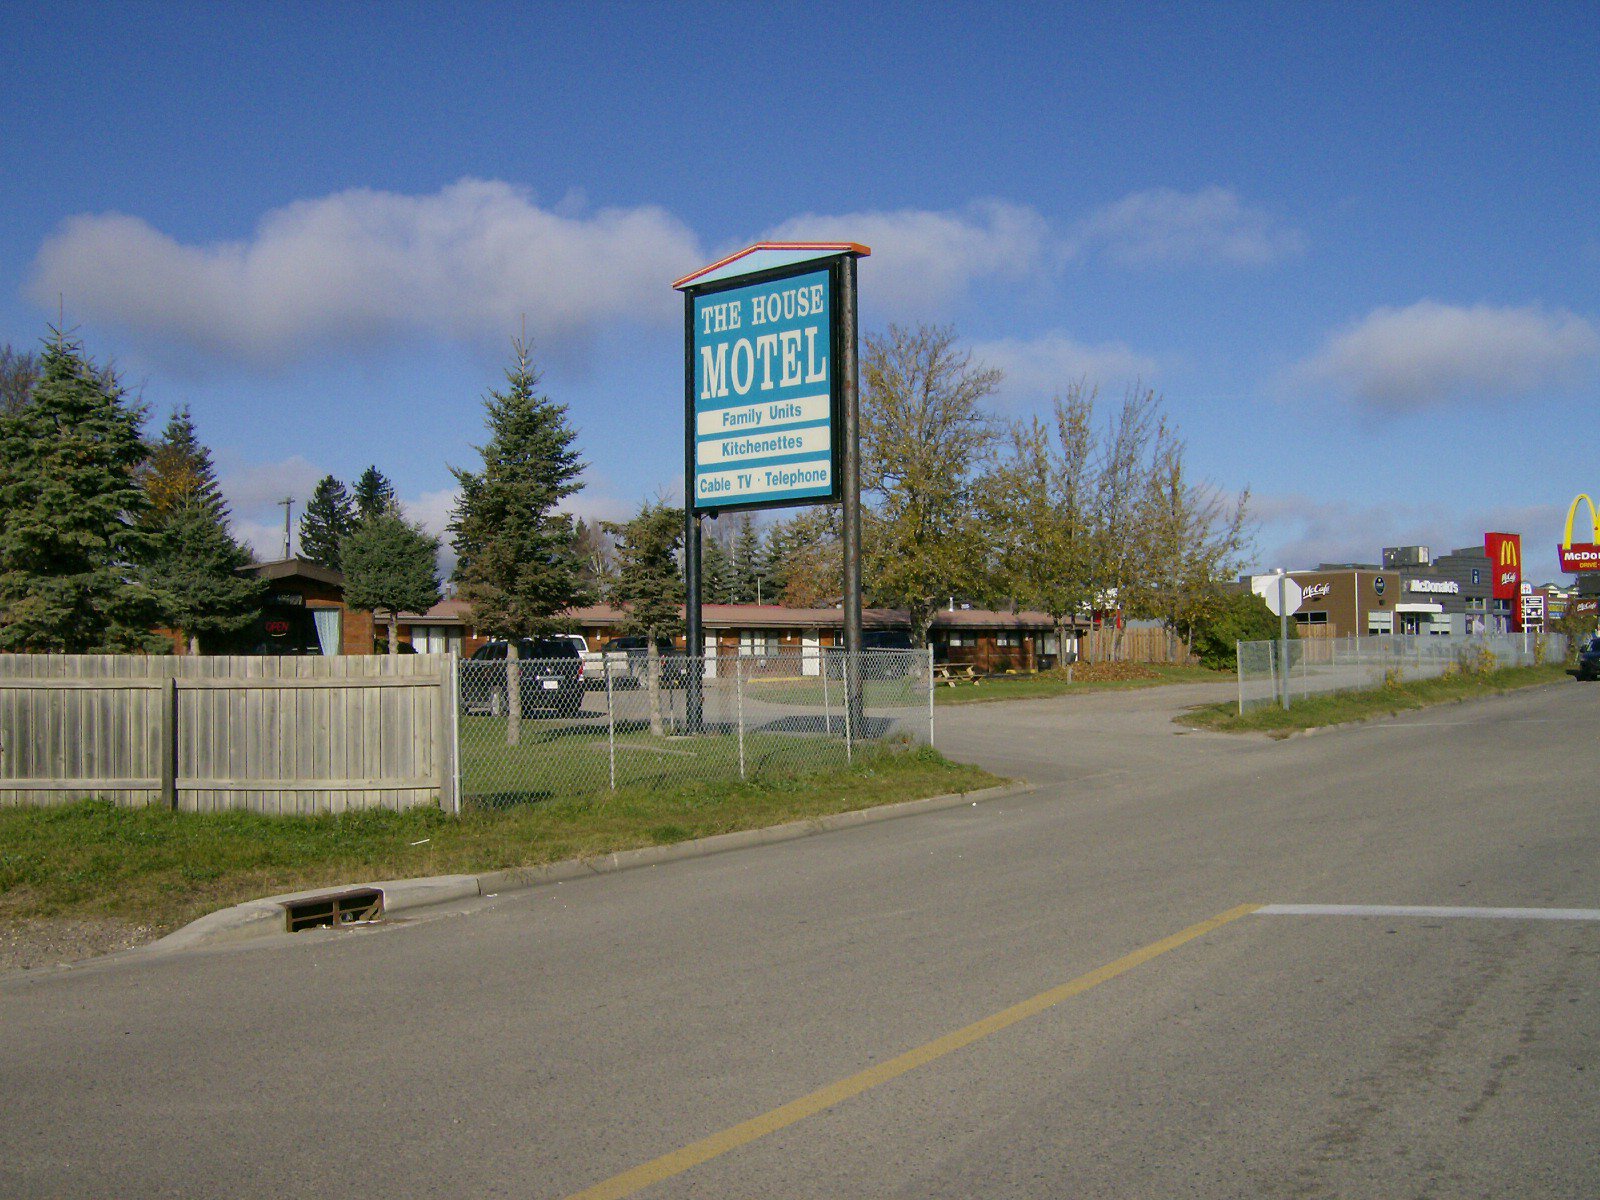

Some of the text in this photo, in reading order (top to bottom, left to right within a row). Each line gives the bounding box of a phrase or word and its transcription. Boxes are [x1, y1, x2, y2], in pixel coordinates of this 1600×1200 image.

[701, 284, 824, 335] THE HOUSE
[700, 326, 827, 400] MOTEL
[722, 403, 802, 427] Family Units
[721, 435, 803, 457] Kitchenettes
[700, 469, 827, 493] Cable TV Telephone
[1564, 551, 1600, 561] McDo
[265, 622, 288, 632] OPEN
